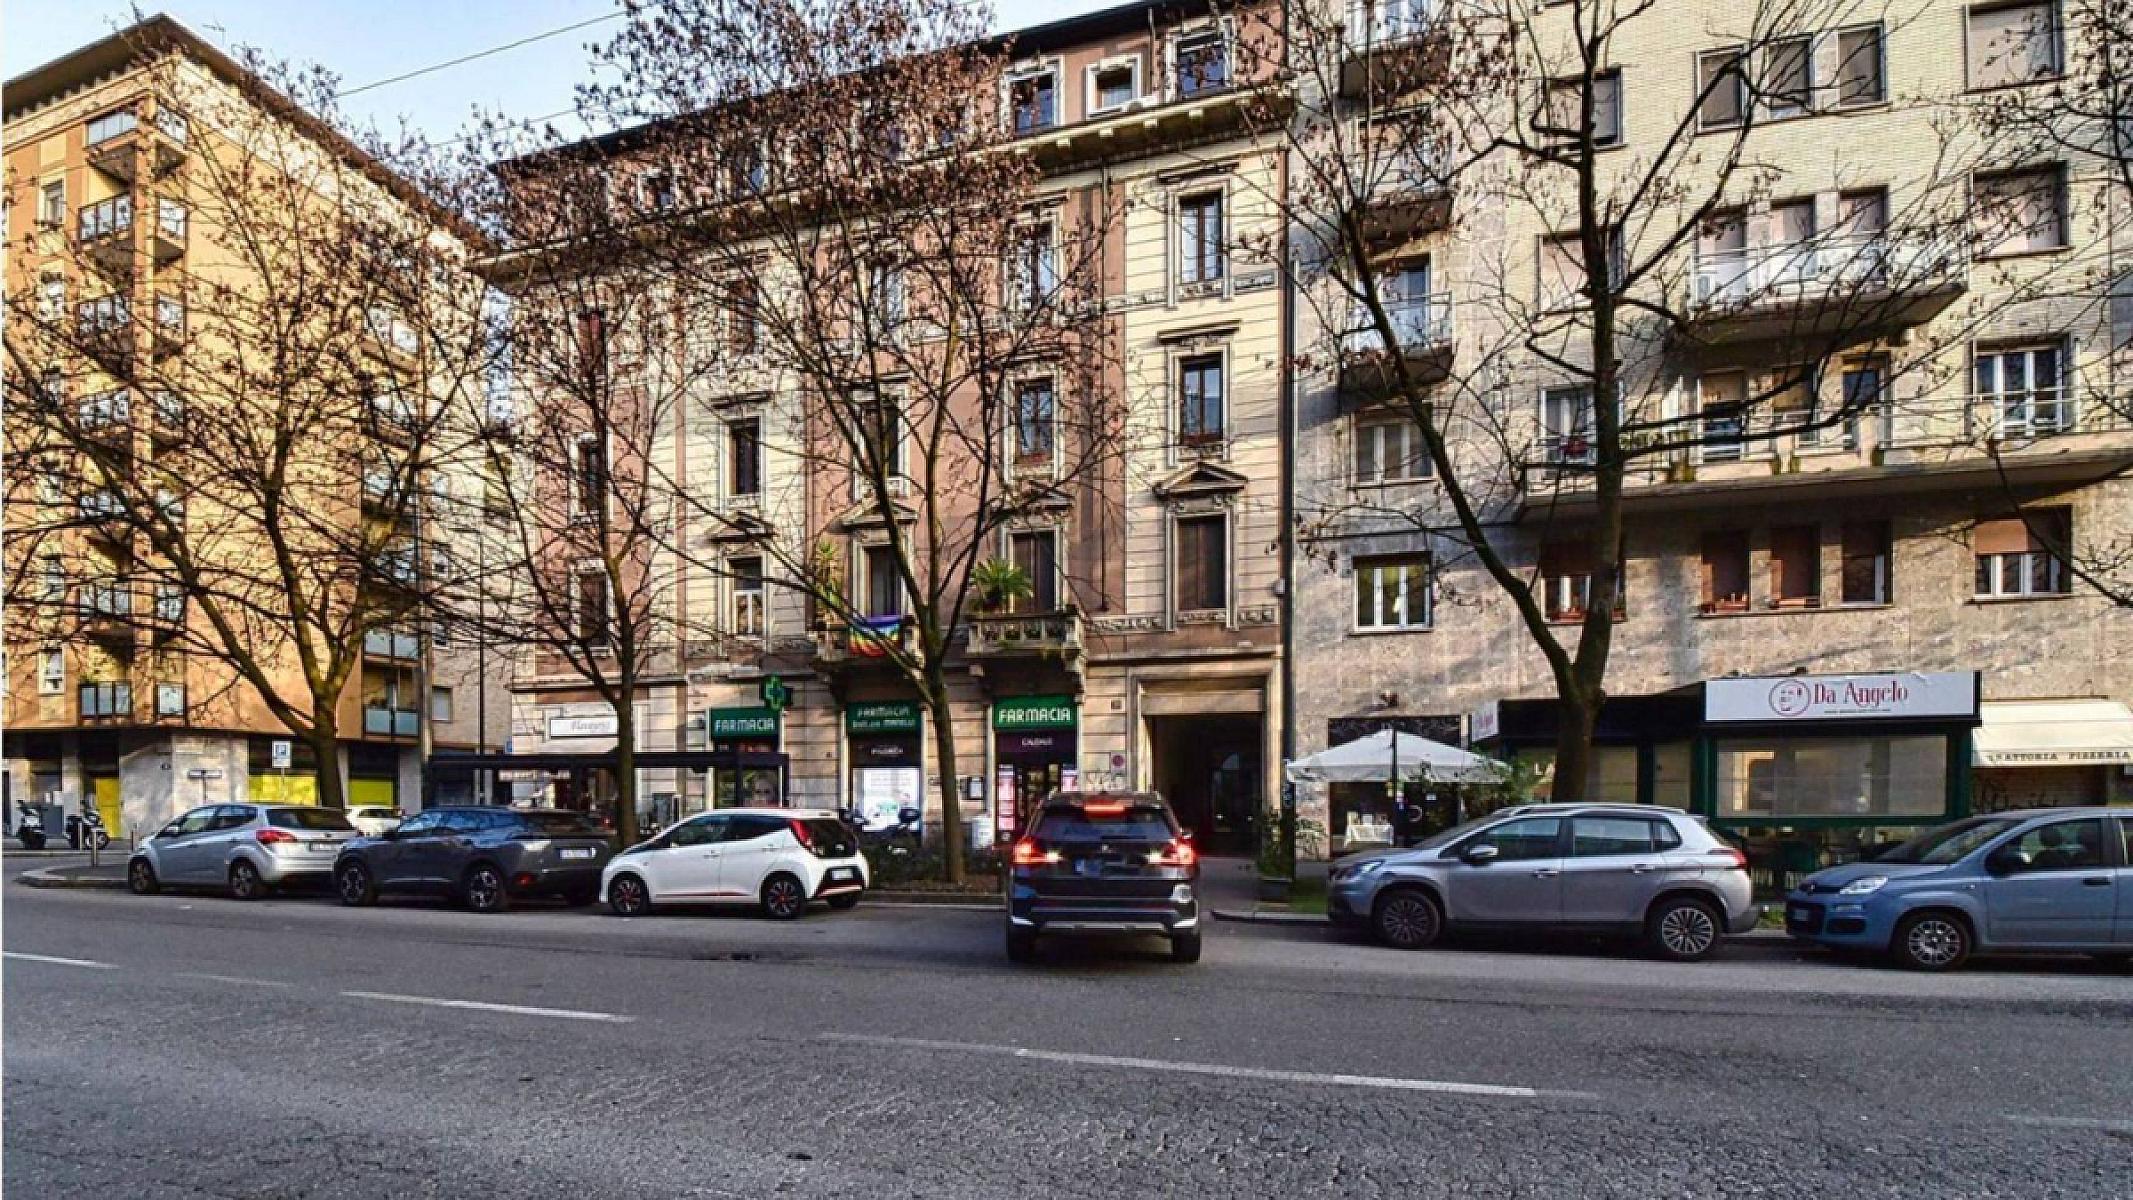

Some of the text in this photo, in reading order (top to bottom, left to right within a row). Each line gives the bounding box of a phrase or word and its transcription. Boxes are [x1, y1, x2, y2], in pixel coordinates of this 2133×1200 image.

[1813, 683, 1837, 704] Da
[1843, 680, 1909, 707] Angelo
[998, 707, 1072, 724] FARMACIA
[715, 717, 775, 732] FARMACIA
[2068, 751, 2130, 760] PIZZERIA
